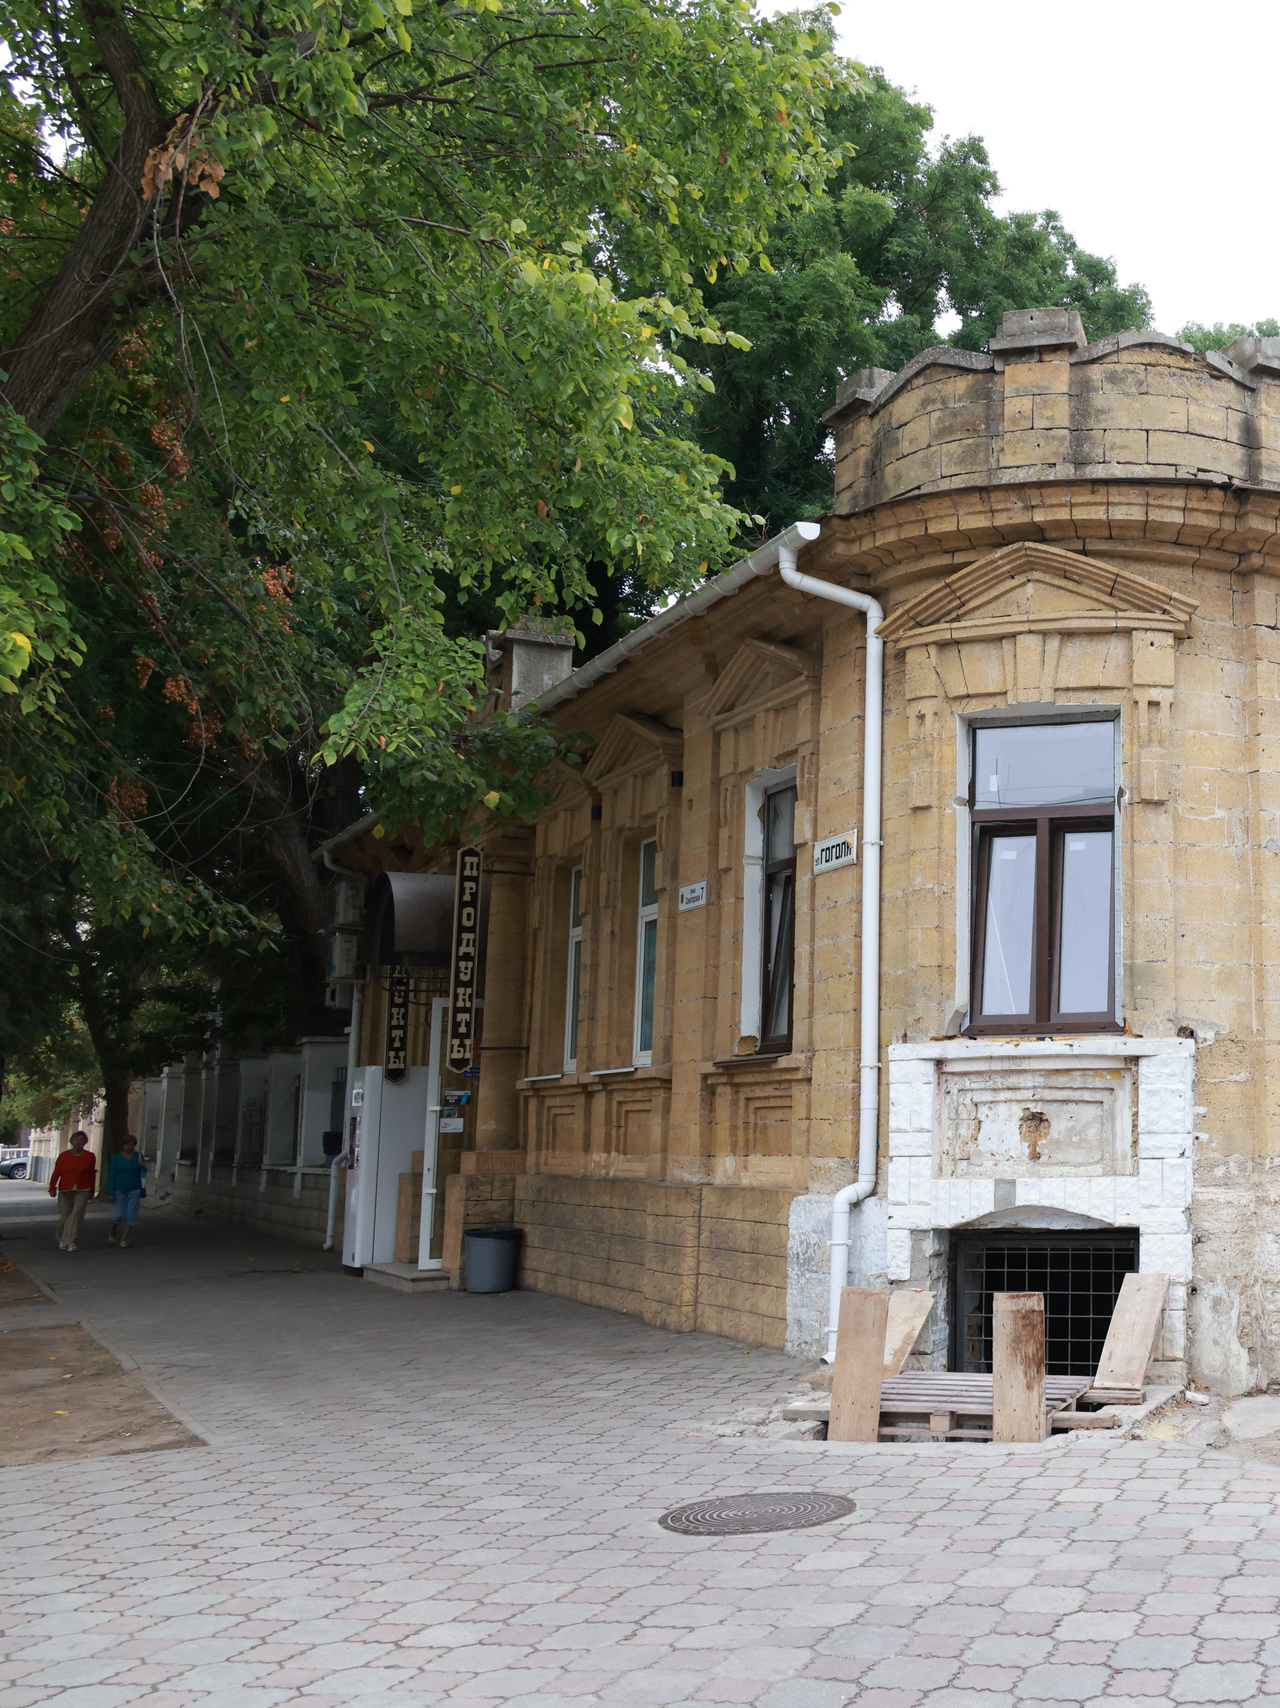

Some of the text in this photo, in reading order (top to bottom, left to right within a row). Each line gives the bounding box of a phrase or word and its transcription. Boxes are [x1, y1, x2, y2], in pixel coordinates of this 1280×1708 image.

[820, 841, 852, 864] ГОГОЛЯ
[700, 886, 704, 900] 7
[450, 856, 479, 1059] ПРОДУКТЫ
[388, 964, 407, 1069] ДУКТЫ
